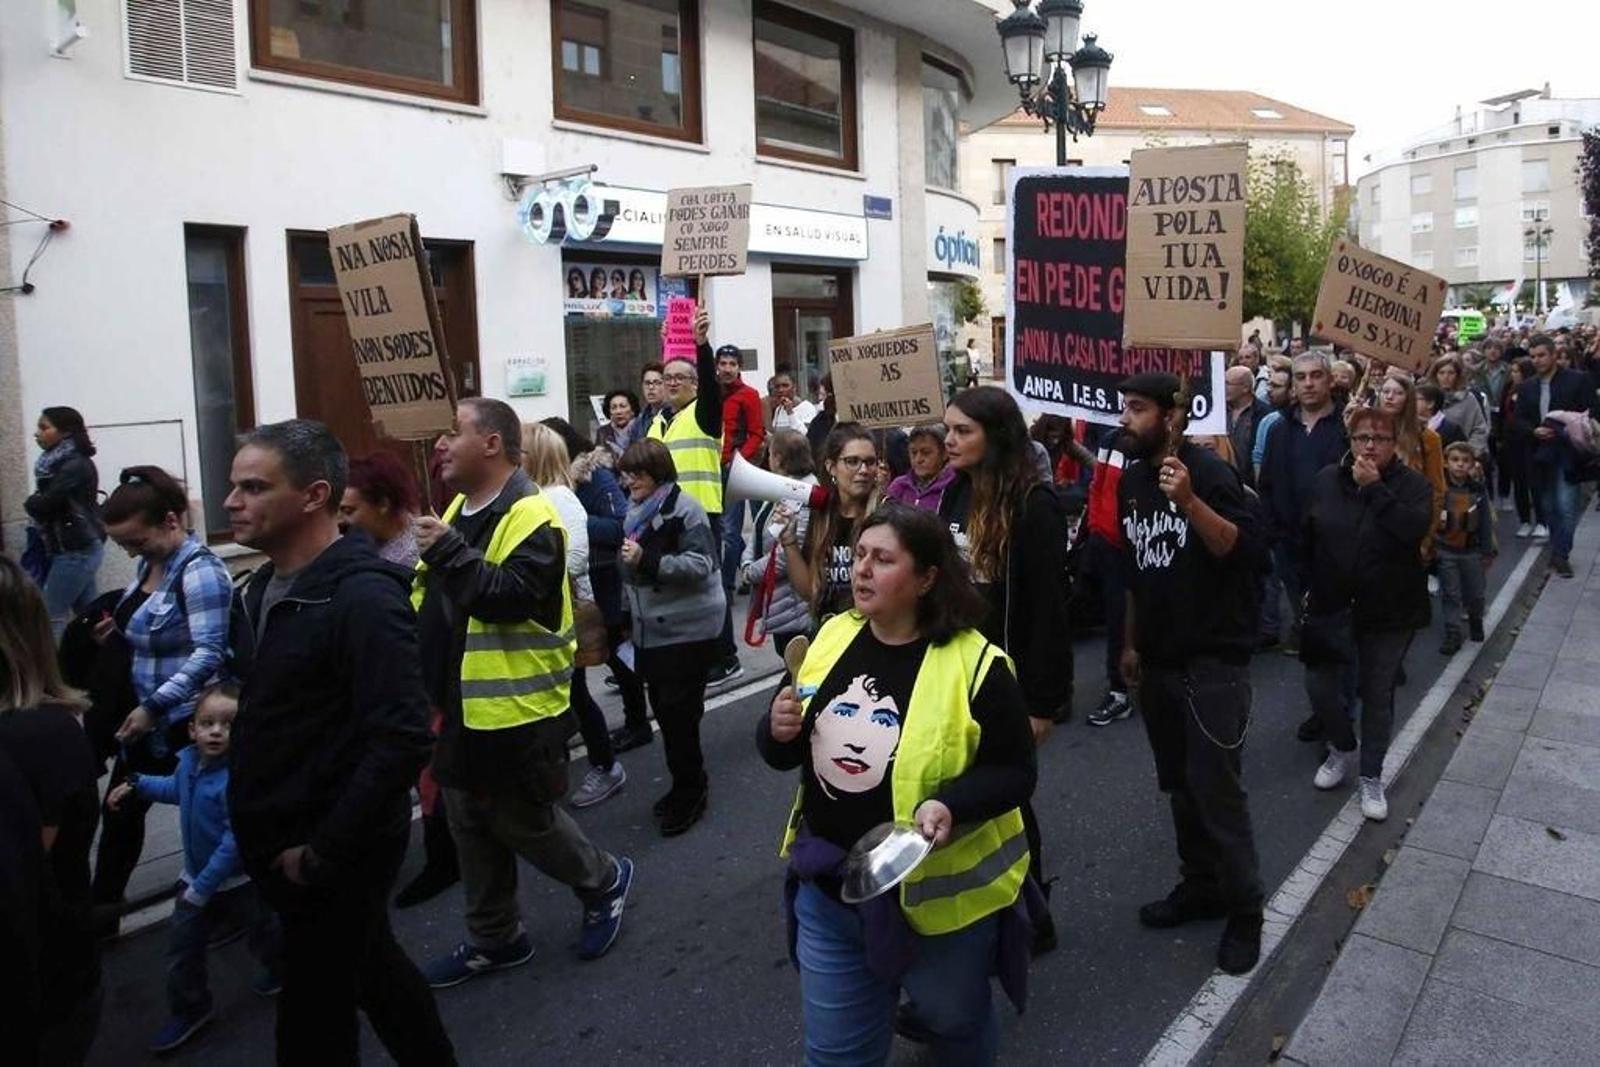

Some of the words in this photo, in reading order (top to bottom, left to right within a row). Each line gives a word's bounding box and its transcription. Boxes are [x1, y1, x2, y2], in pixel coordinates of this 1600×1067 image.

[703, 192, 736, 205] LOITA
[1132, 172, 1244, 207] APOSTA
[669, 206, 707, 222] PODES
[680, 222, 694, 235] CO
[698, 220, 729, 233] XOGO
[1036, 192, 1126, 241] REDOND
[1153, 209, 1227, 236] POLA
[673, 235, 728, 252] SEMPRE
[766, 223, 781, 236] EN
[785, 225, 821, 240] SALUD
[825, 230, 862, 243] VISUAL
[336, 243, 367, 272] NA
[369, 231, 416, 265] NOSA
[678, 253, 737, 270] PERDES
[1162, 243, 1225, 268] TUA
[1016, 258, 1039, 303] EN
[1142, 271, 1230, 310] VIDA!
[1396, 271, 1411, 295] É
[1413, 284, 1428, 304] A
[346, 285, 392, 317] VILA
[1346, 285, 1422, 331] HEROINA
[1333, 310, 1360, 334] DO
[352, 335, 385, 365] NON
[382, 330, 433, 362] SODES
[831, 346, 852, 363] NON
[857, 338, 919, 359] XOGUEDES
[1051, 332, 1062, 364] A
[1064, 333, 1098, 371] CASA
[1099, 338, 1120, 374] DE
[880, 362, 902, 382] AS
[361, 372, 447, 406] BENVIDOS
[1023, 375, 1064, 401] ANPA
[1072, 383, 1112, 410] I.E.S.
[849, 397, 931, 421] MAQUINITAS
[1123, 509, 1188, 548] Working
[1136, 539, 1175, 570] Class
